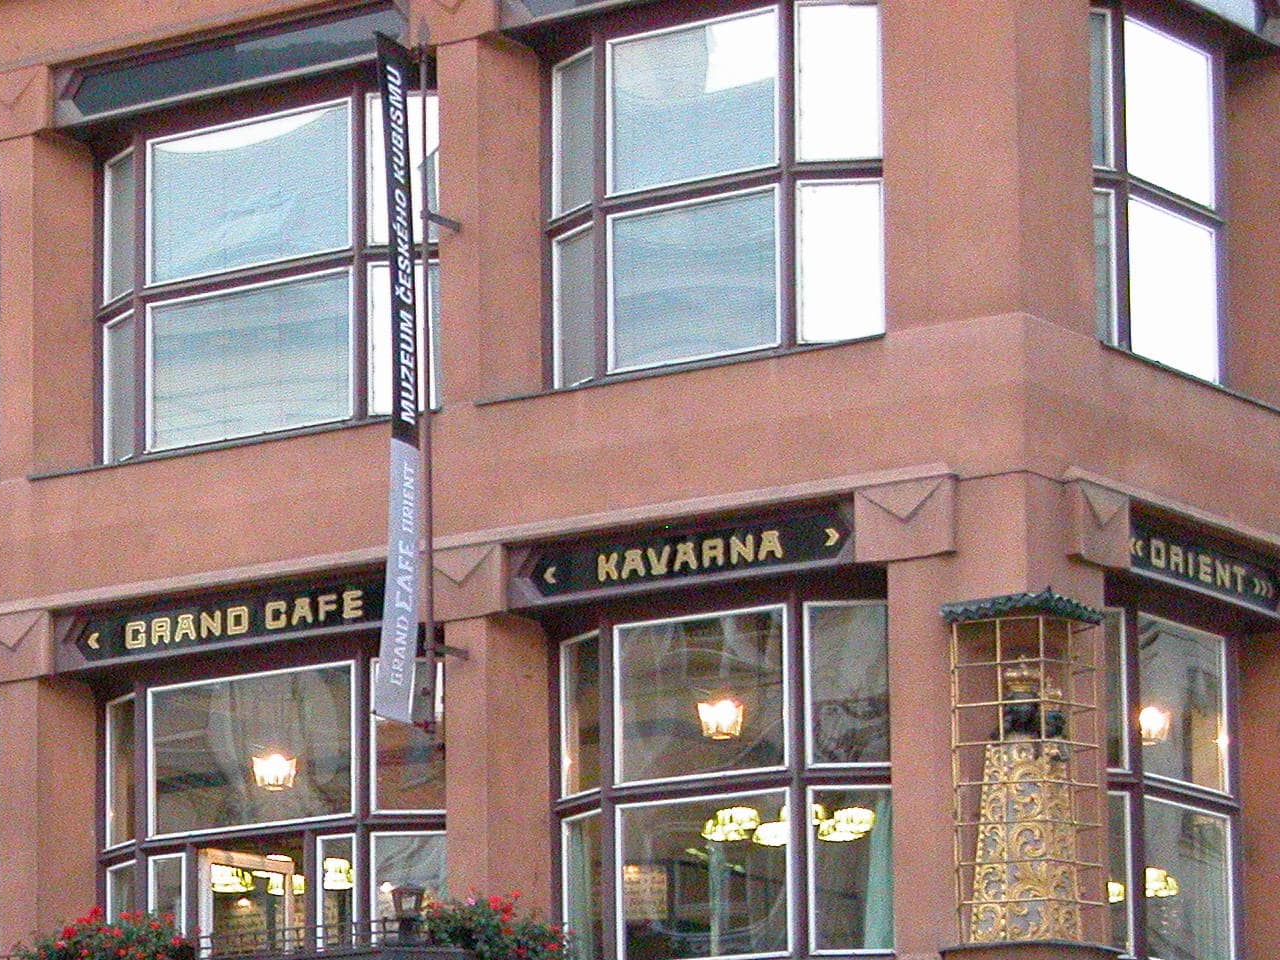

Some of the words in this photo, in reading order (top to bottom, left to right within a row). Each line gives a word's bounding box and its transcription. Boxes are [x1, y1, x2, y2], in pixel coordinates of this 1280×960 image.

[385, 64, 408, 186] KUBISMU
[392, 187, 415, 302] ČESKÉHO
[396, 309, 417, 426] MUZEUM
[1150, 537, 1246, 593] ORIENT
[124, 605, 250, 650] GRAND
[264, 589, 365, 630] CAFE
[390, 613, 410, 687] GRAND
